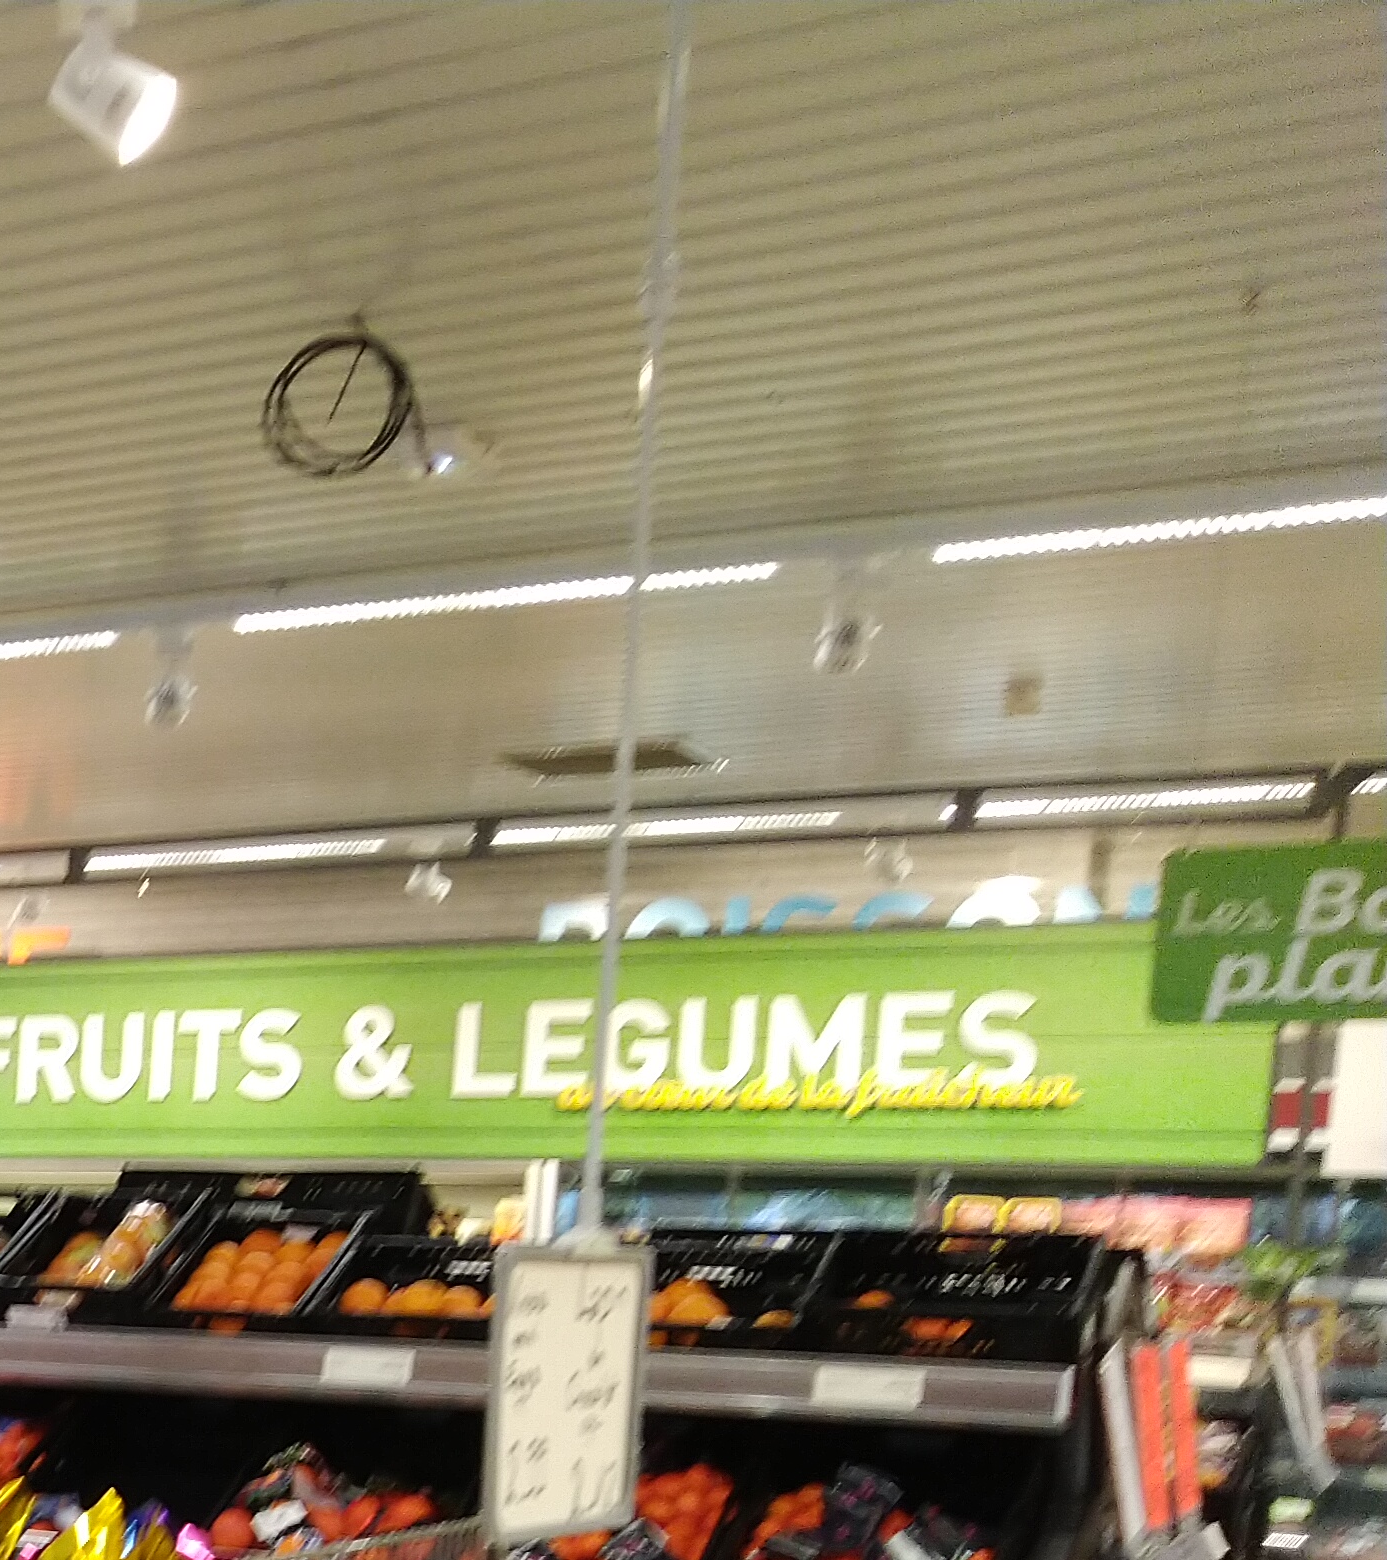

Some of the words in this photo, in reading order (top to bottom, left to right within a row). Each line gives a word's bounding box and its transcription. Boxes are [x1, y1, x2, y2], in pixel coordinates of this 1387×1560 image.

[1173, 888, 1281, 936] Les
[1202, 938, 1387, 1024] pla
[334, 1003, 415, 1101] &
[448, 990, 1040, 1103] LEGUMES
